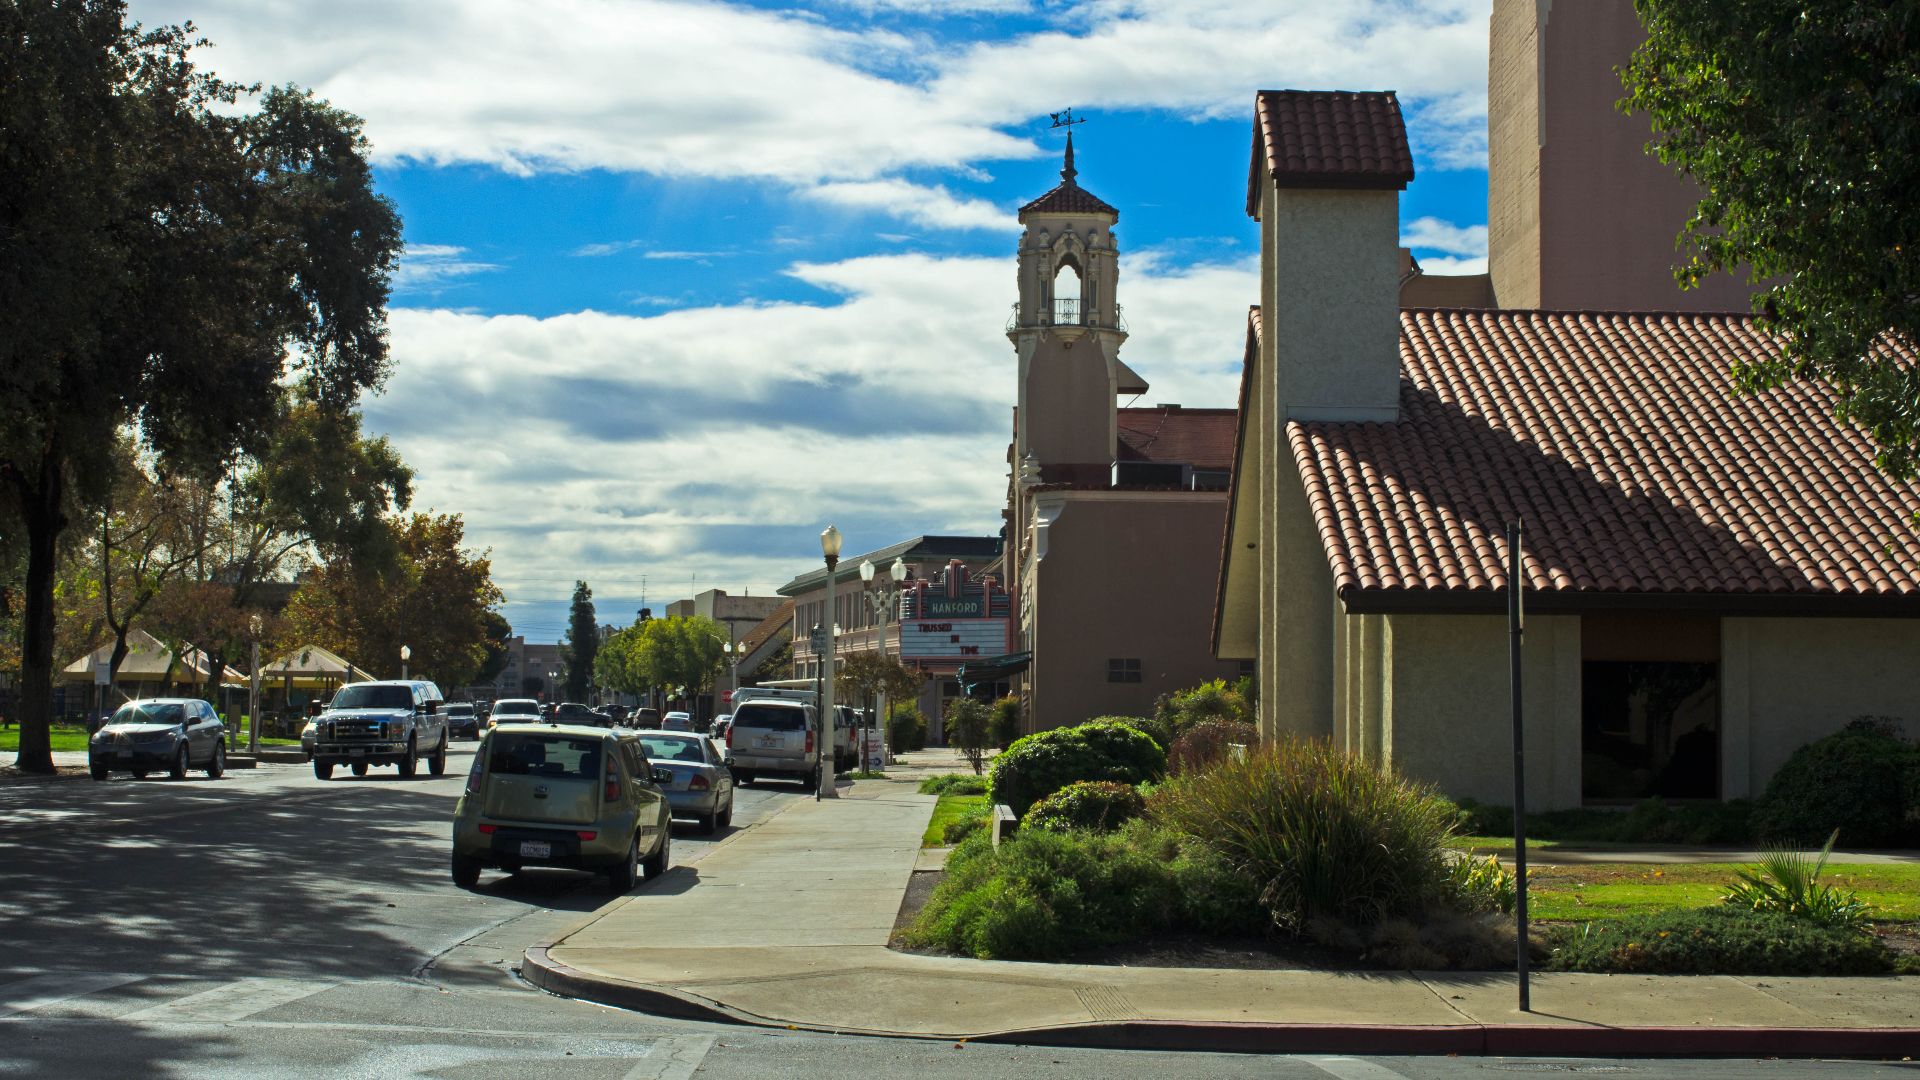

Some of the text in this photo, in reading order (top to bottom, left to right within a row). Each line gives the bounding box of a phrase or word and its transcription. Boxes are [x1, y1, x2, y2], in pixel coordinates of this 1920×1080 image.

[932, 602, 978, 614] HANFORD
[917, 623, 953, 633] TRUSSED
[950, 634, 960, 643] IN
[959, 645, 980, 655] TIME
